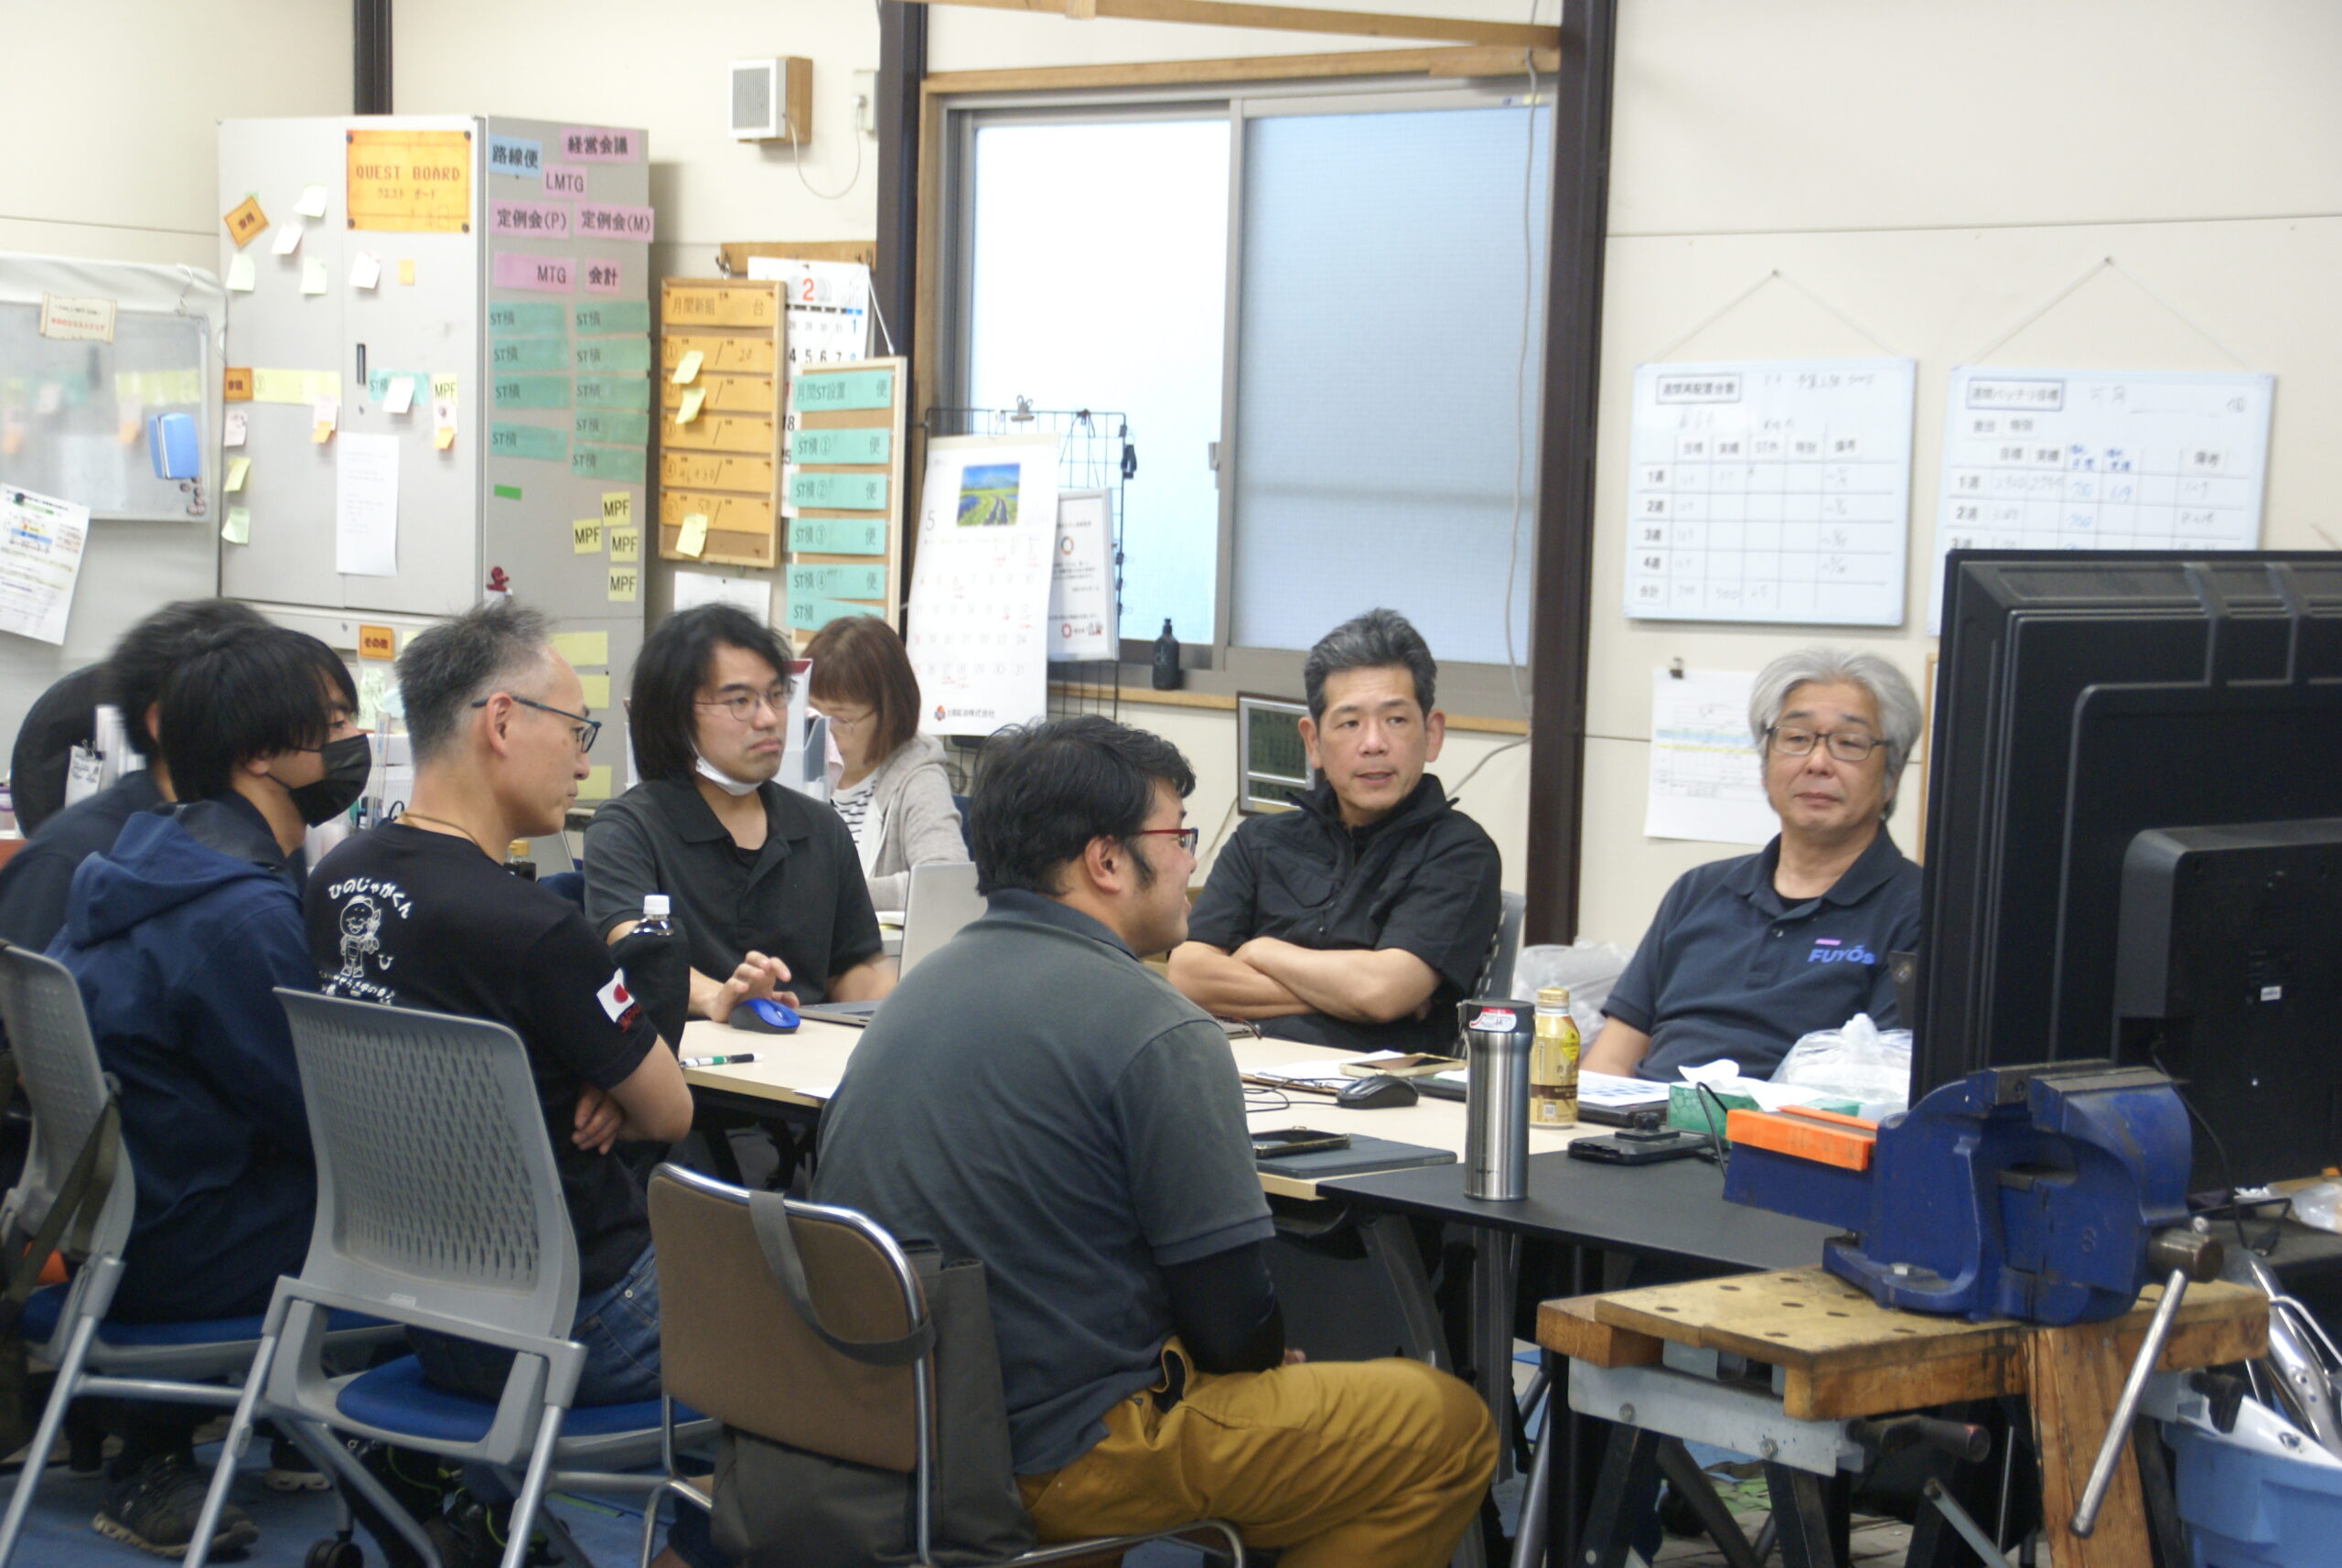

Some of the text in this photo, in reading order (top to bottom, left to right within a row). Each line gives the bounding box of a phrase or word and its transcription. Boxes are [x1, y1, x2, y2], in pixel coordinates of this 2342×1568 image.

[567, 134, 628, 156] 経営会議
[491, 145, 539, 169] 路線便
[356, 165, 460, 181] QUEST BOARD
[546, 172, 585, 193] LMTG
[497, 208, 567, 231] 定例会(P)
[581, 209, 651, 233] 定例会(M)
[537, 264, 566, 285] MTG
[589, 266, 618, 286] 会計
[802, 278, 814, 301] 2
[435, 382, 456, 400] MPF
[604, 499, 629, 518] MPF
[925, 510, 935, 532] 5
[575, 527, 600, 545] MPF
[611, 536, 638, 553] MPF
[610, 575, 637, 592] MPF
[328, 877, 413, 919] ひのじゃがくん
